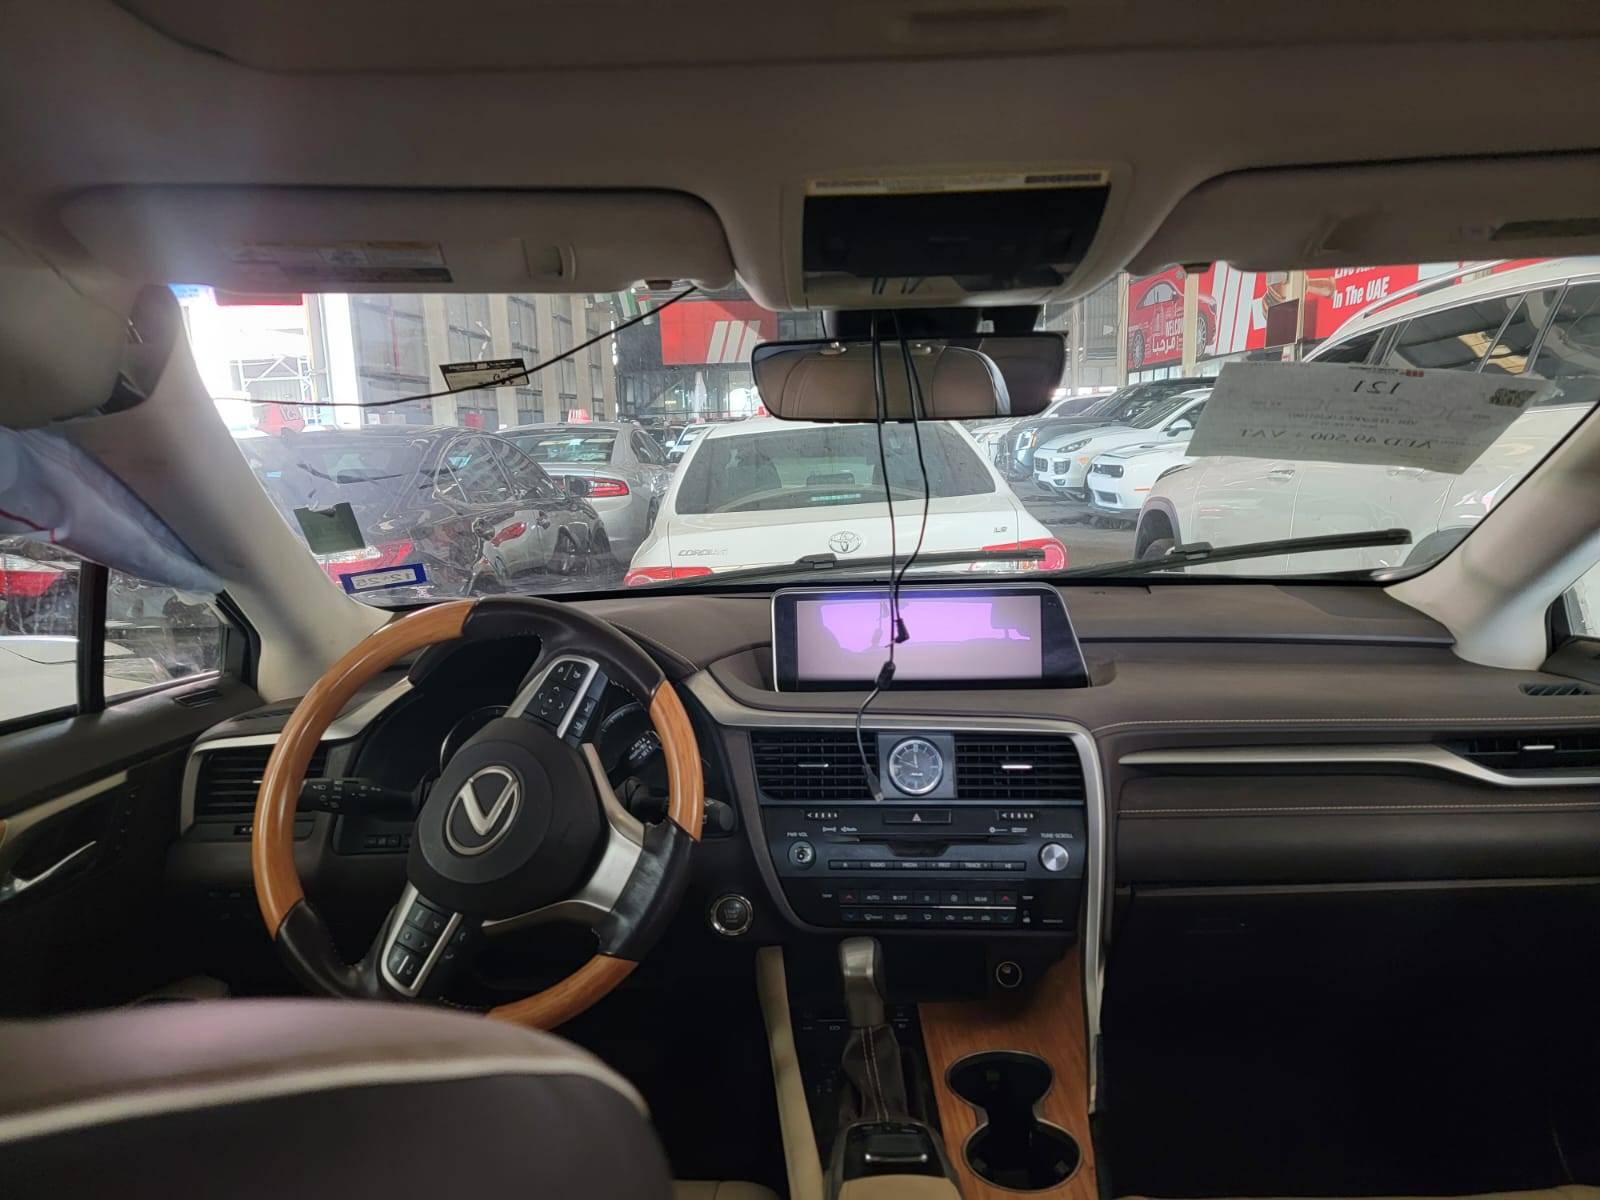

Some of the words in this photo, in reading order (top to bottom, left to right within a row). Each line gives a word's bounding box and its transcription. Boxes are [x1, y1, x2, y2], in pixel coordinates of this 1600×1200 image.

[1332, 290, 1343, 309] In
[1345, 285, 1364, 306] The
[1366, 275, 1390, 301] UAE
